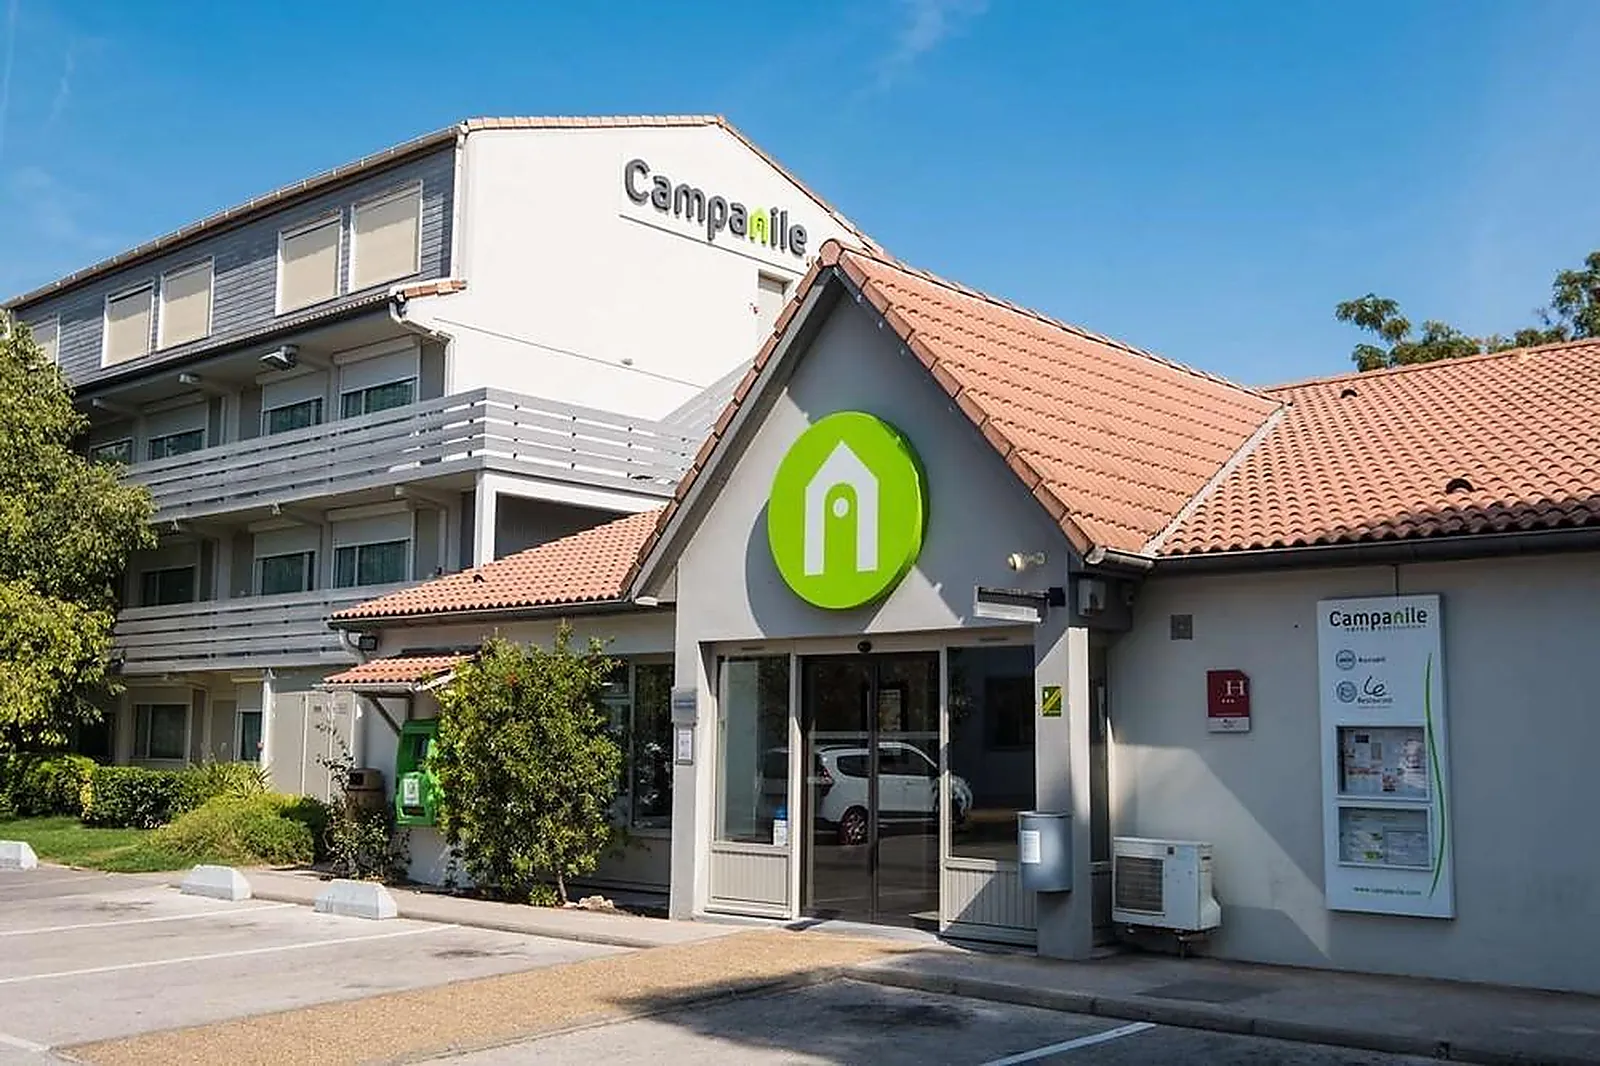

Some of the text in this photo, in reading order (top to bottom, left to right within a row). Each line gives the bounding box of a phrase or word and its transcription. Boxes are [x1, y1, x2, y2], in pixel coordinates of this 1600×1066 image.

[624, 158, 807, 256] Campanile
[1329, 607, 1428, 630] Campanile
[1226, 680, 1244, 696] H
